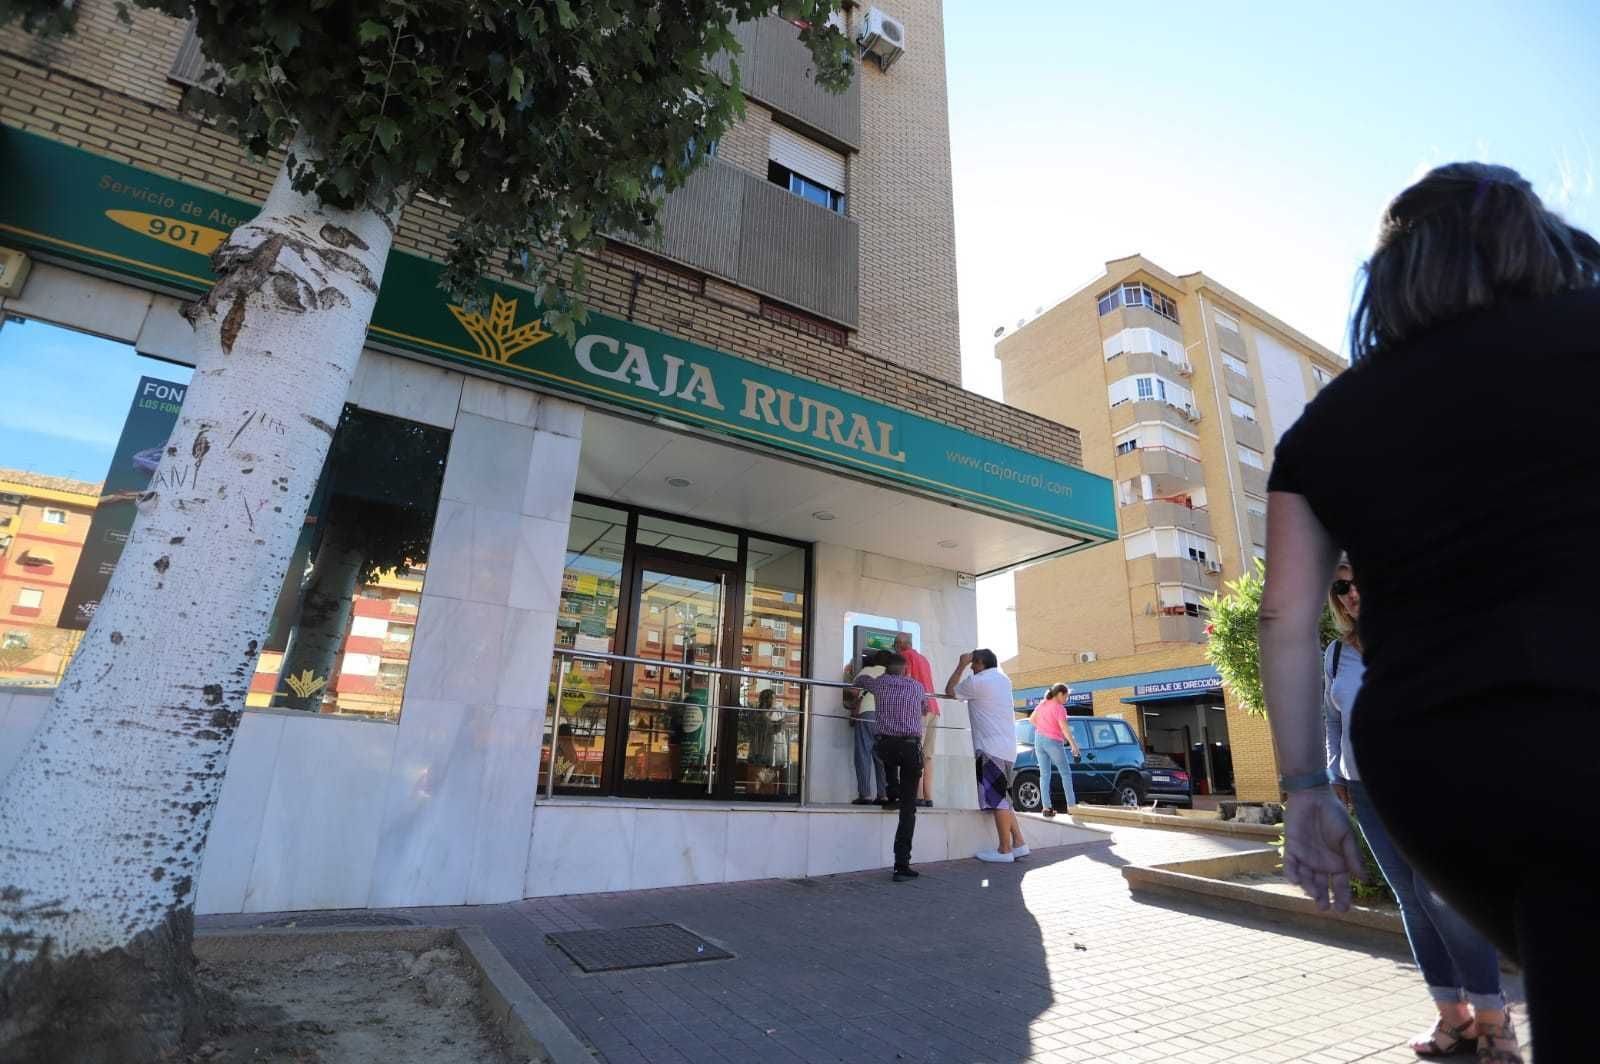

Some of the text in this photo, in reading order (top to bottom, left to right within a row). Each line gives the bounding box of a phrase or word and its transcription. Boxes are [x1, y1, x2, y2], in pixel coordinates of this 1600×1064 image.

[98, 175, 175, 208] Servicio
[181, 200, 203, 217] de
[148, 219, 200, 246] 901
[143, 382, 184, 402] FON
[574, 334, 906, 463] CAJA RURAL
[945, 450, 1073, 497] www.cajarural.com
[1145, 683, 1172, 695] REGLAJE
[1173, 682, 1182, 690] DE
